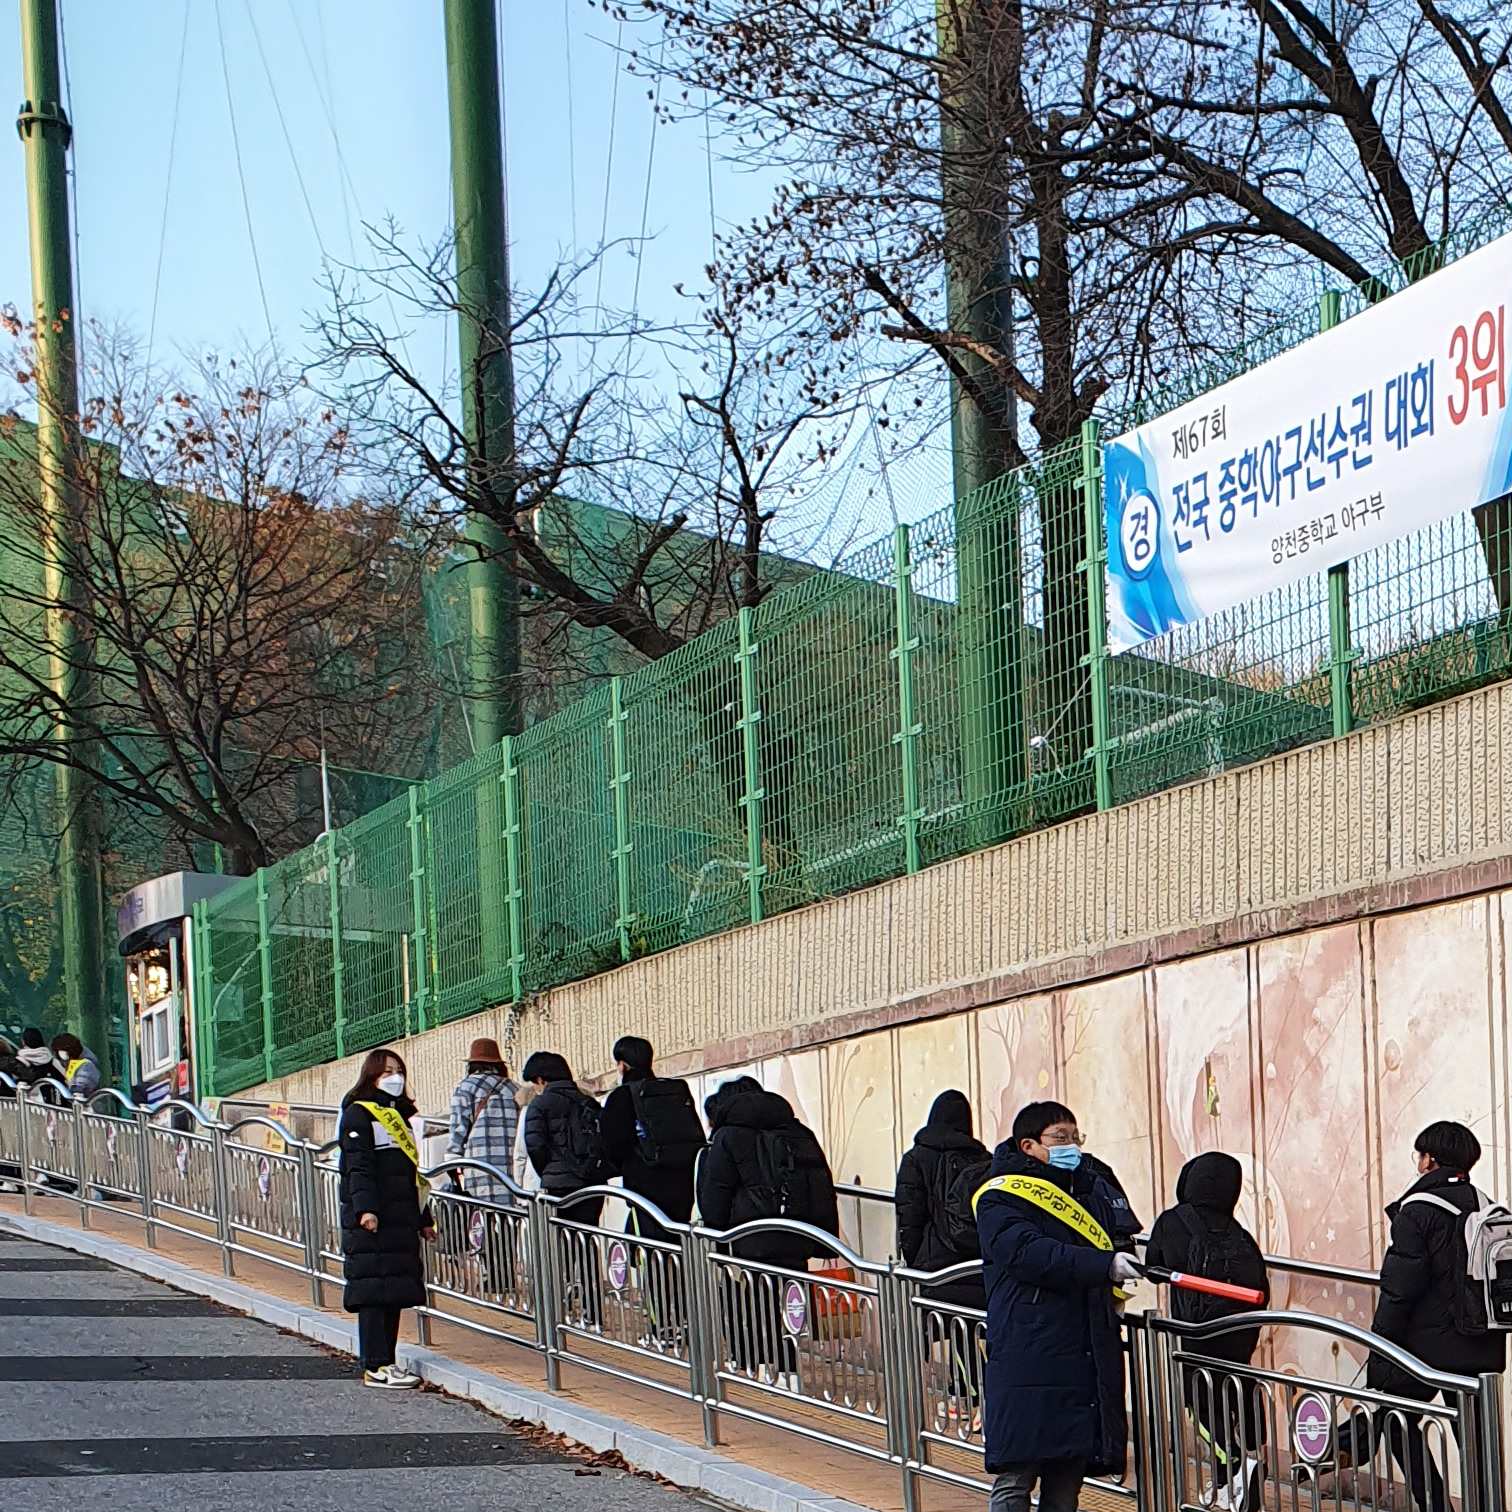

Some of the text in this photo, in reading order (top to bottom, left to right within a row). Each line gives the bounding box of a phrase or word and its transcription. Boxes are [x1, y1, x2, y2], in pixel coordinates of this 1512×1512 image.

[1171, 405, 1228, 460] 제67회
[1172, 304, 1506, 554] 전국 중학야구선수권 대회 3위
[1129, 507, 1151, 563] 경
[1271, 490, 1386, 565] 양천중학교 야구부
